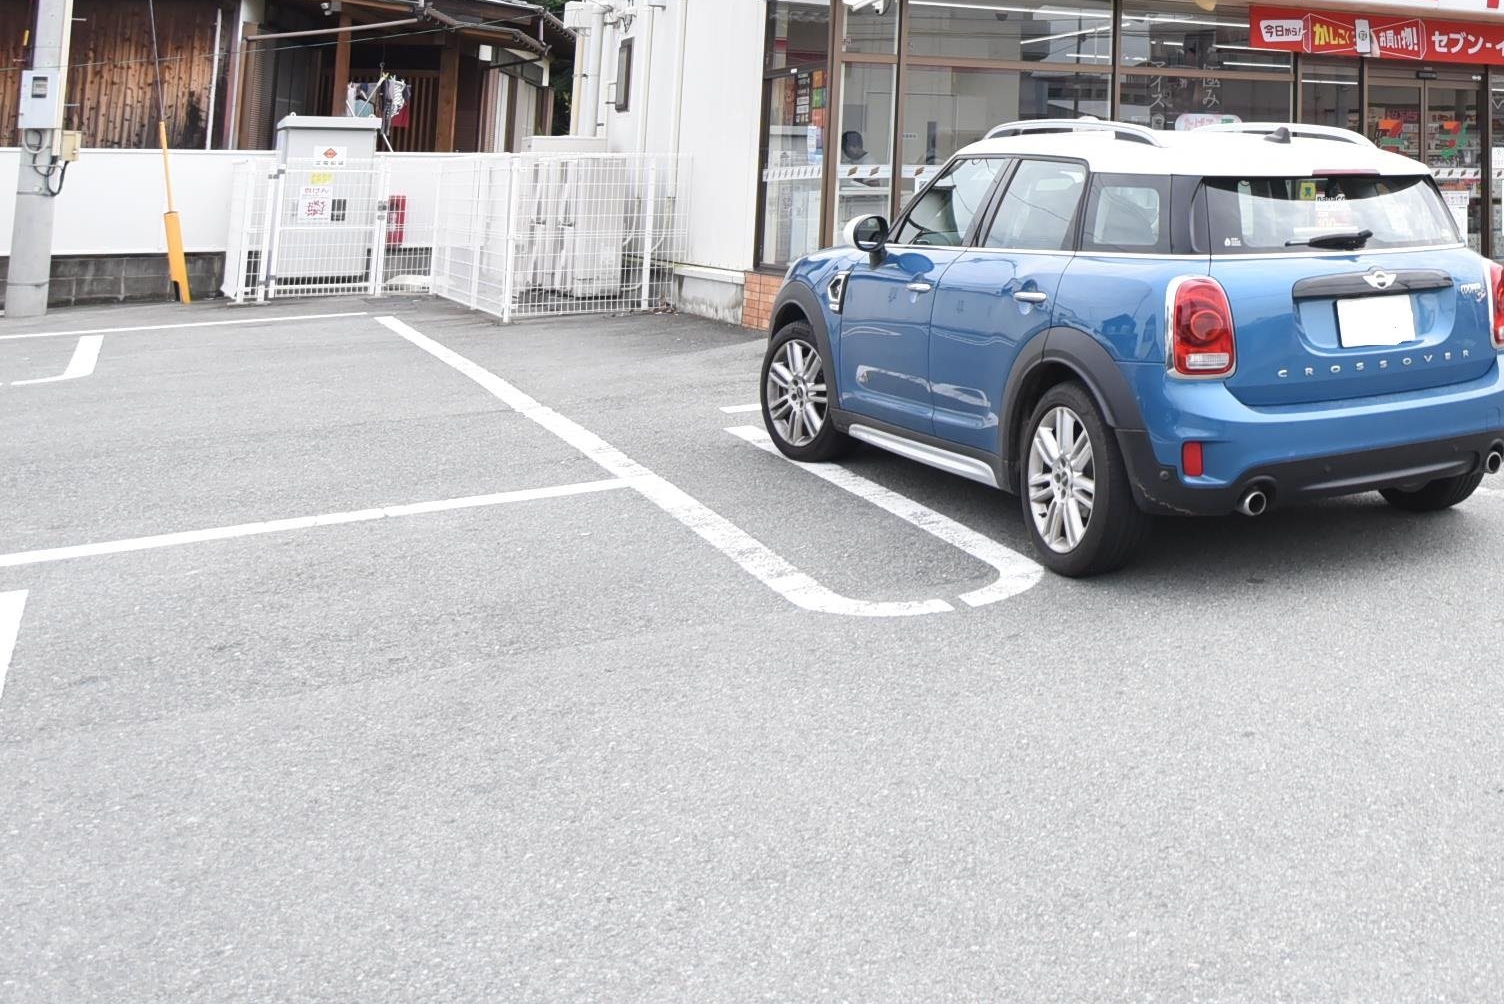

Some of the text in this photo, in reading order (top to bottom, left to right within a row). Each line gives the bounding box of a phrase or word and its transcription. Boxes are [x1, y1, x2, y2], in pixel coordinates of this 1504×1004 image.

[1313, 23, 1350, 45] かしこく
[1277, 349, 1470, 378] CROSSOVER
